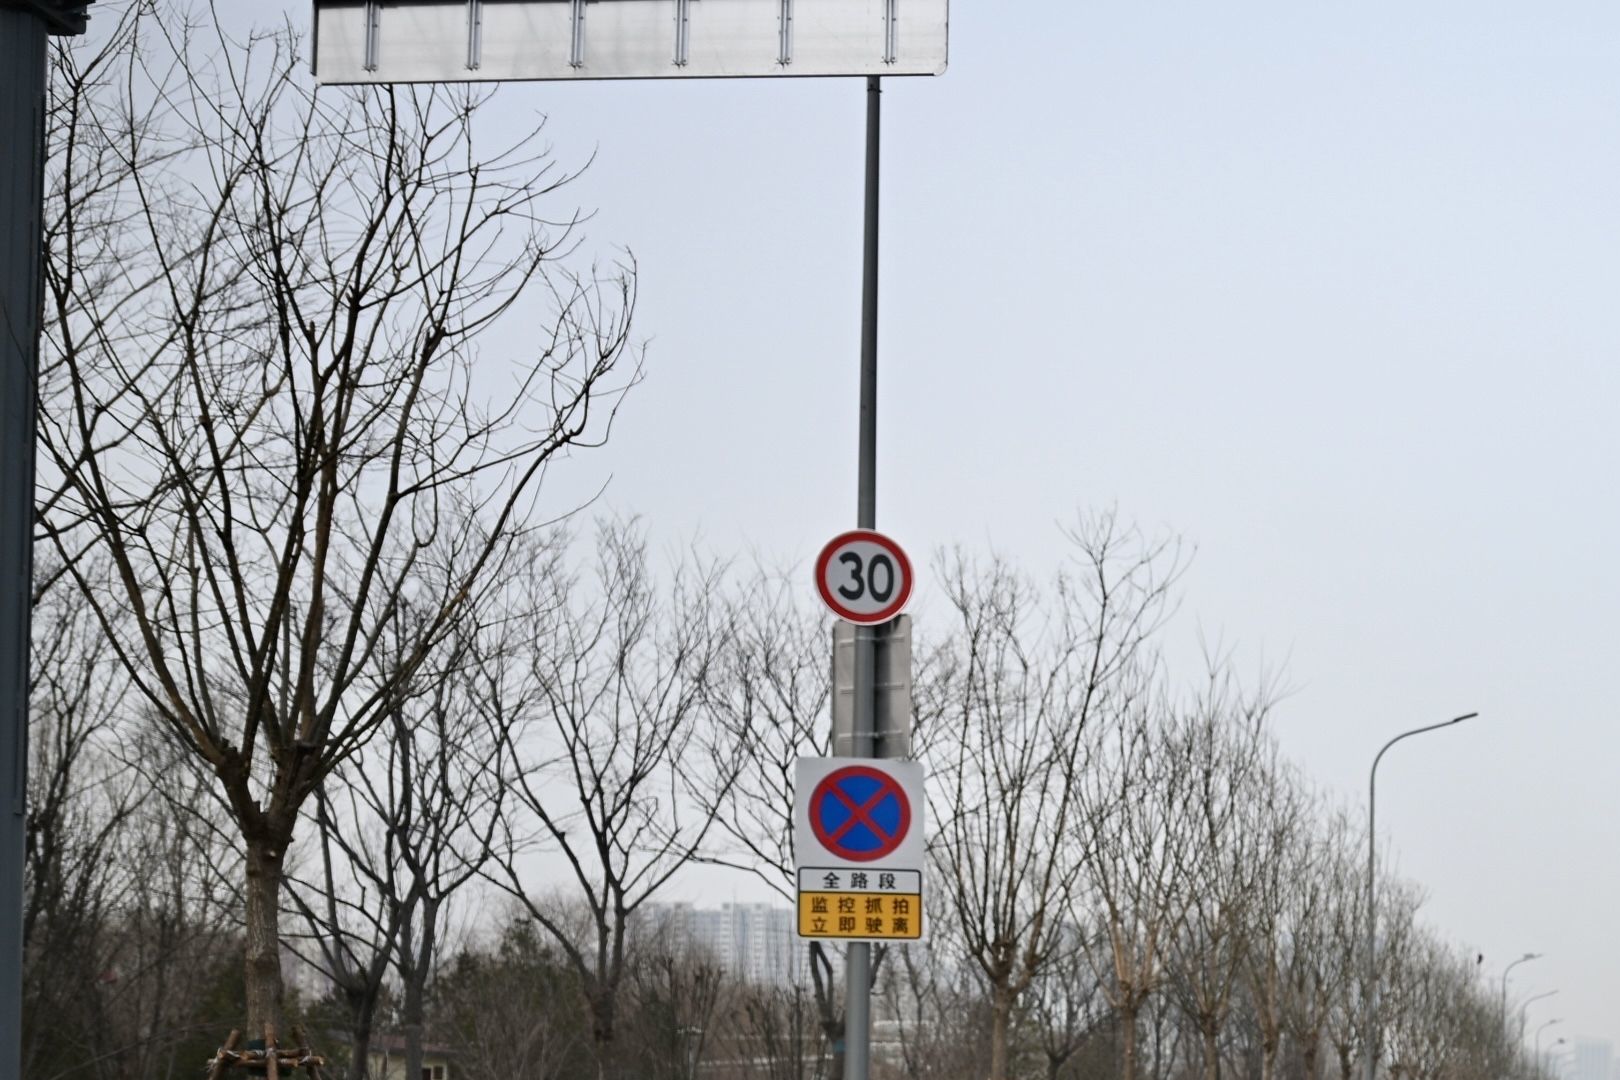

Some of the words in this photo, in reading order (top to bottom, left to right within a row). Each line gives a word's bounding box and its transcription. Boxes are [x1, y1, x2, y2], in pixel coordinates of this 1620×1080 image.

[837, 551, 895, 603] 30
[823, 871, 897, 889] 全路段
[811, 896, 909, 914] 监控抓拍
[811, 916, 909, 934] 立即驶离
